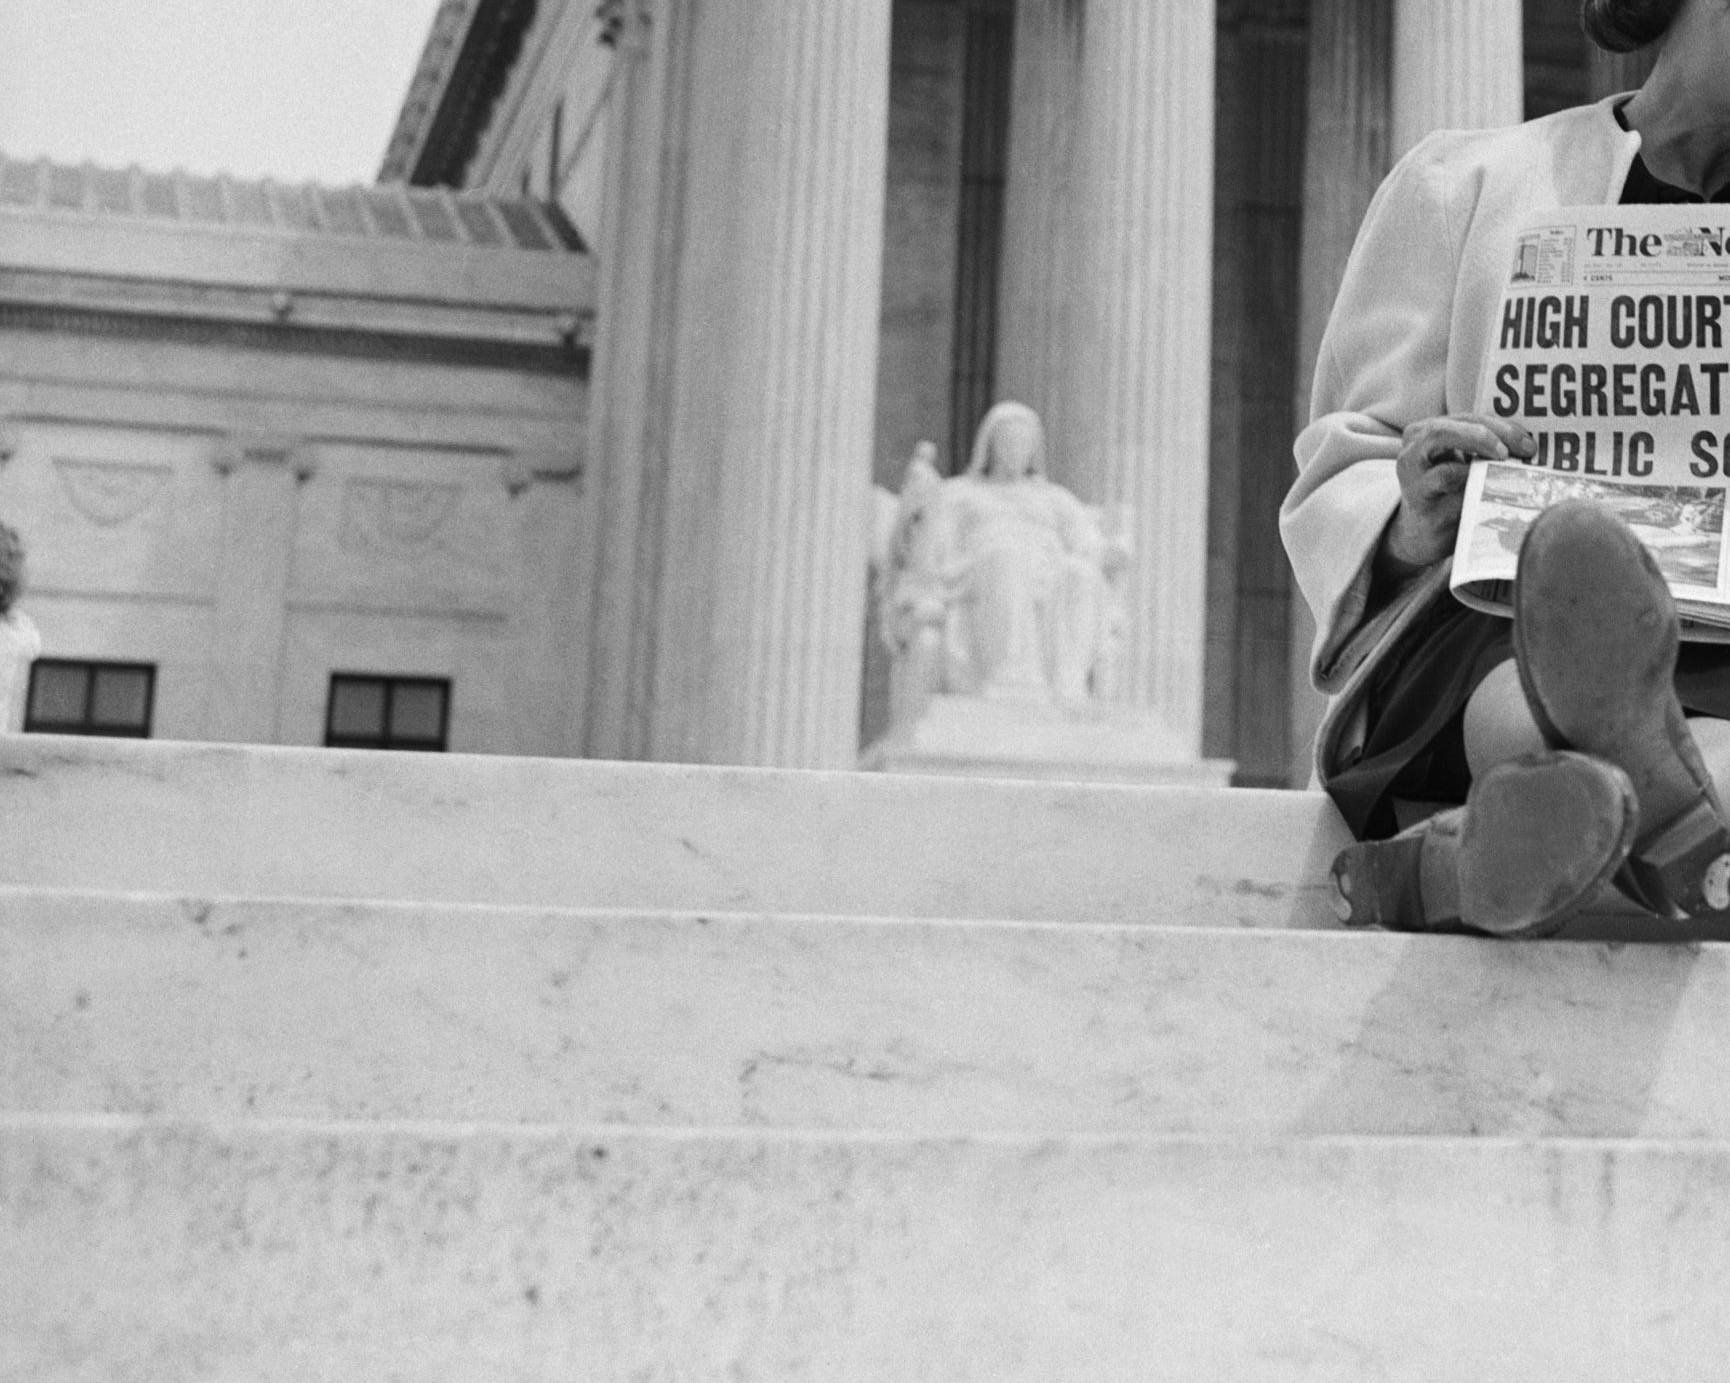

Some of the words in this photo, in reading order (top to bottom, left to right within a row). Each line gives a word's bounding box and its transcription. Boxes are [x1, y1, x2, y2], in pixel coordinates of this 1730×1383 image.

[1587, 227, 1662, 257] The
[1499, 294, 1589, 349] HIGH
[1521, 430, 1655, 477] UBLIC
